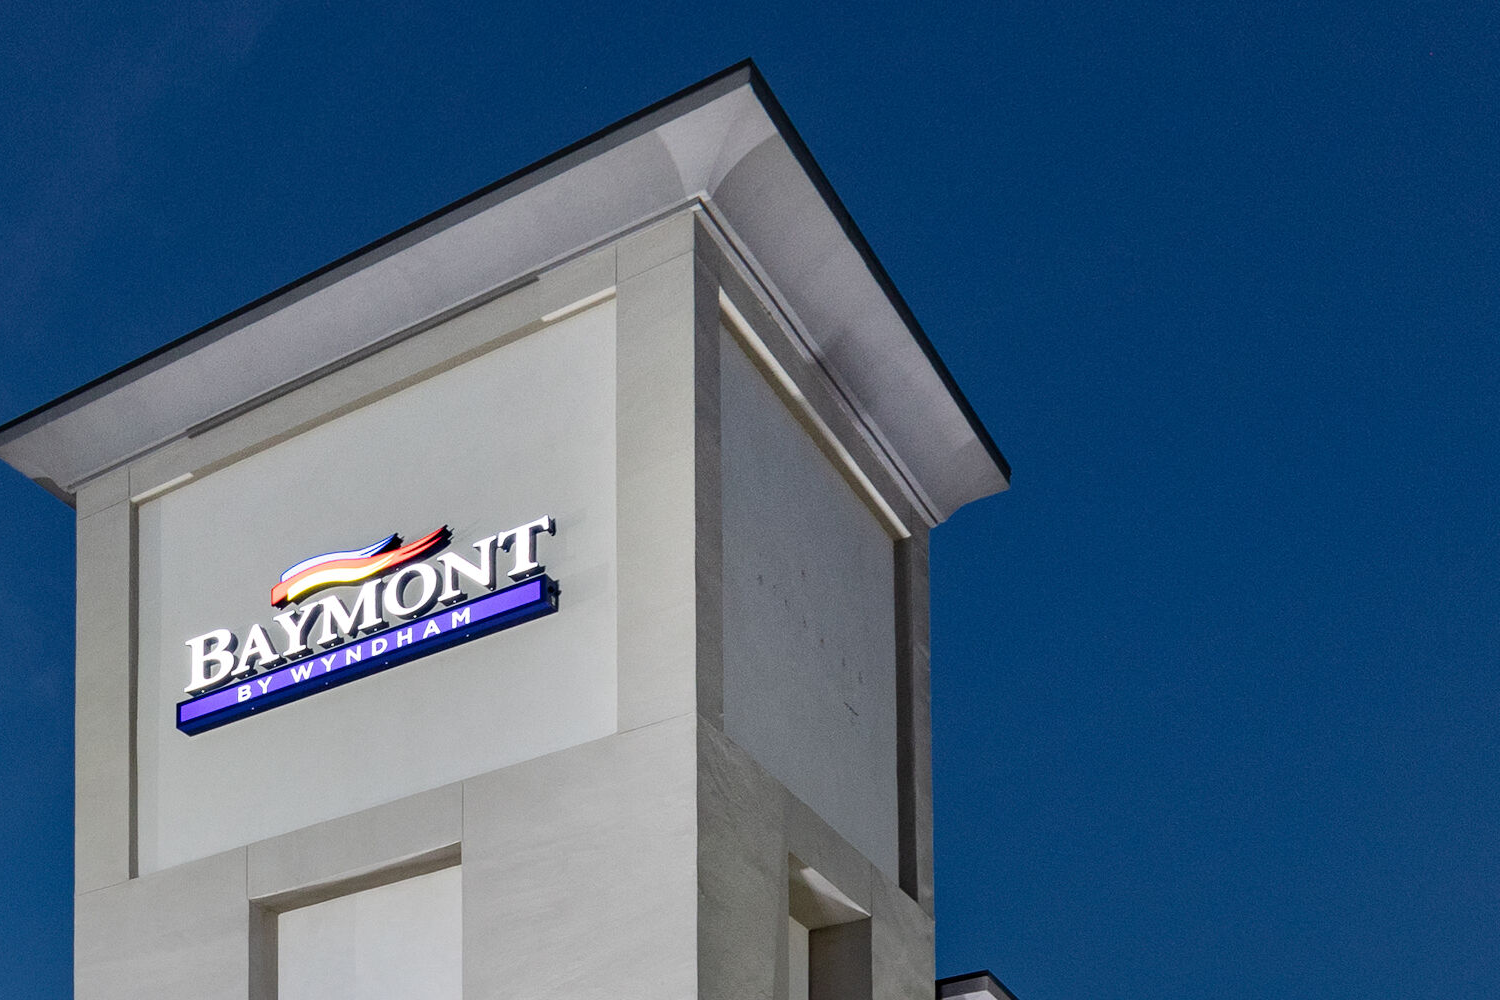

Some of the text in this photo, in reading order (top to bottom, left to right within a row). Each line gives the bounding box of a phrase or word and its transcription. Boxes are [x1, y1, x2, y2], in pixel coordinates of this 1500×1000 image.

[184, 515, 551, 694] BAYMONT
[237, 607, 472, 702] BY WYNDHAM
